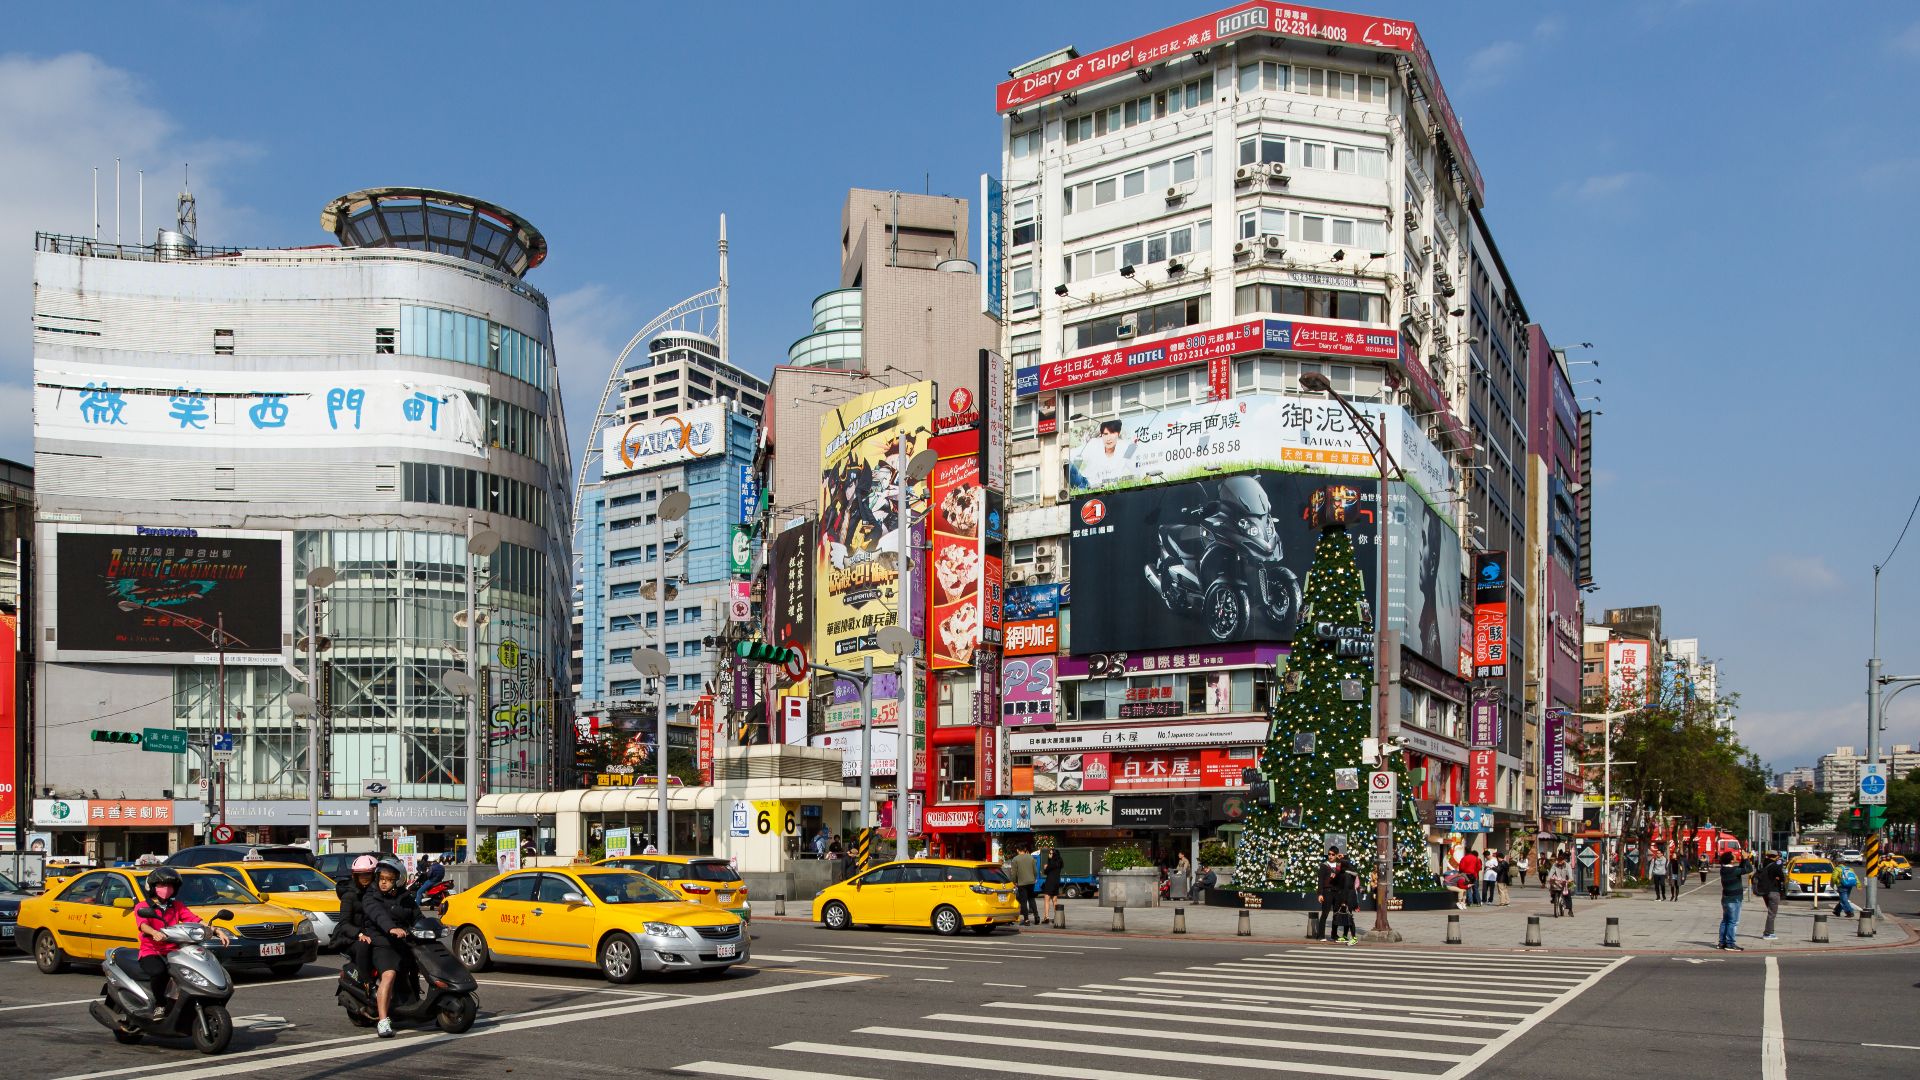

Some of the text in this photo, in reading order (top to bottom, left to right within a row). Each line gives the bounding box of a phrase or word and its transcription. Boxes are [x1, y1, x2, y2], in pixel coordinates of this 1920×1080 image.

[1219, 9, 1266, 34] HOTEL
[1274, 19, 1347, 42] 02-2314-4003
[1383, 22, 1412, 41] Diary
[1023, 46, 1134, 93] Diary of Taipei
[1318, 342, 1333, 350] Diary
[1339, 343, 1353, 351] Taipei
[1366, 335, 1394, 346] HOTEL
[1128, 349, 1164, 366] HOTEL
[1067, 371, 1084, 382] Diary
[1084, 370, 1092, 378] of
[80, 382, 442, 431] 微笑西門町
[1135, 412, 1240, 446] 您的御用面膜
[620, 416, 712, 470] GALAXY
[1303, 436, 1352, 448] TAIWAN
[953, 461, 967, 475] Great
[967, 457, 976, 467] Day
[136, 525, 198, 537] Panasonic
[1005, 625, 1045, 650] 網咖
[1045, 624, 1055, 646] 4F
[1317, 621, 1363, 637] CLASH
[1489, 626, 1503, 660] 駭客
[1088, 652, 1128, 682] PS
[1143, 653, 1224, 670] 國際髮型 中華店
[1003, 658, 1053, 696] PS
[1477, 665, 1504, 678] 網咖
[1125, 686, 1173, 701] 名留集團
[1022, 716, 1033, 724] 3F
[214, 734, 224, 746] P
[1102, 731, 1139, 744] 白木屋
[1157, 730, 1171, 739] No.1
[984, 732, 994, 782] 白木屋
[1124, 756, 1191, 778] 白木屋
[1475, 752, 1490, 790] 白木屋
[1553, 750, 1563, 786] HOTEL
[597, 773, 634, 786] 西門町
[91, 806, 169, 819] 真善美劇院
[382, 806, 429, 818] 誠品生活
[430, 807, 447, 817] the
[1034, 799, 1111, 816] 成都楊桃冰
[757, 810, 771, 835] 6
[784, 810, 796, 834] 6
